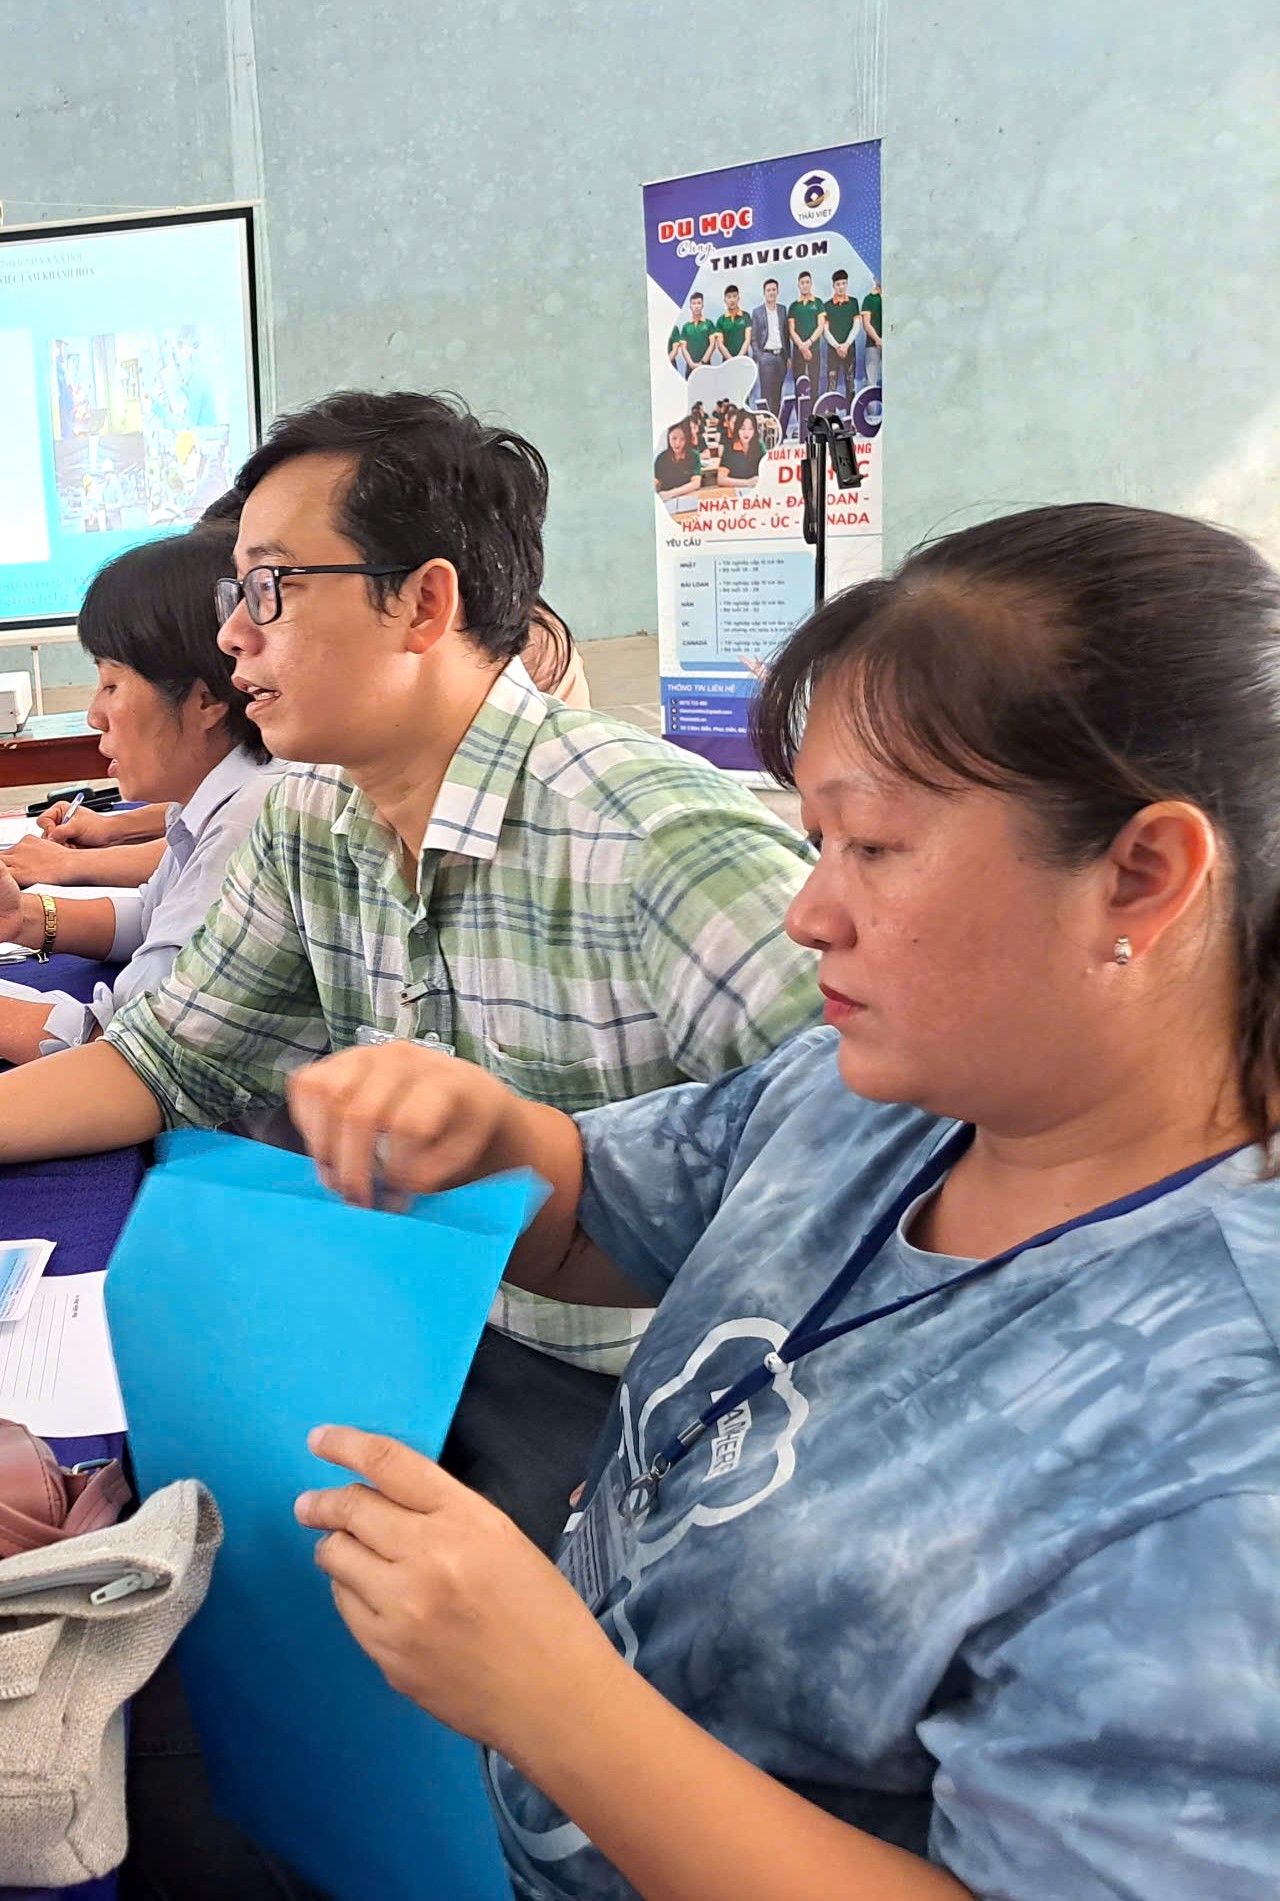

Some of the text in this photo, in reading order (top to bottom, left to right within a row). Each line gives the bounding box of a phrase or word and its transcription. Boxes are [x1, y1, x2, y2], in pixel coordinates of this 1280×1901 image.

[660, 209, 751, 241] DU HỌC
[798, 208, 833, 221] THÁI VIỆT
[677, 241, 714, 266] Cùng
[710, 241, 828, 271] THAVICOM
[768, 447, 792, 461] XUẤT
[699, 498, 737, 514] NHẬT
[743, 494, 771, 511] BẢN
[827, 492, 859, 506] OAN
[682, 512, 870, 533] HÀN QUỐC ÚC NADA
[666, 538, 682, 548] YÊU
[667, 683, 693, 692] THÔNG
[694, 684, 706, 692] TIN
[707, 684, 723, 693] LIÊN
